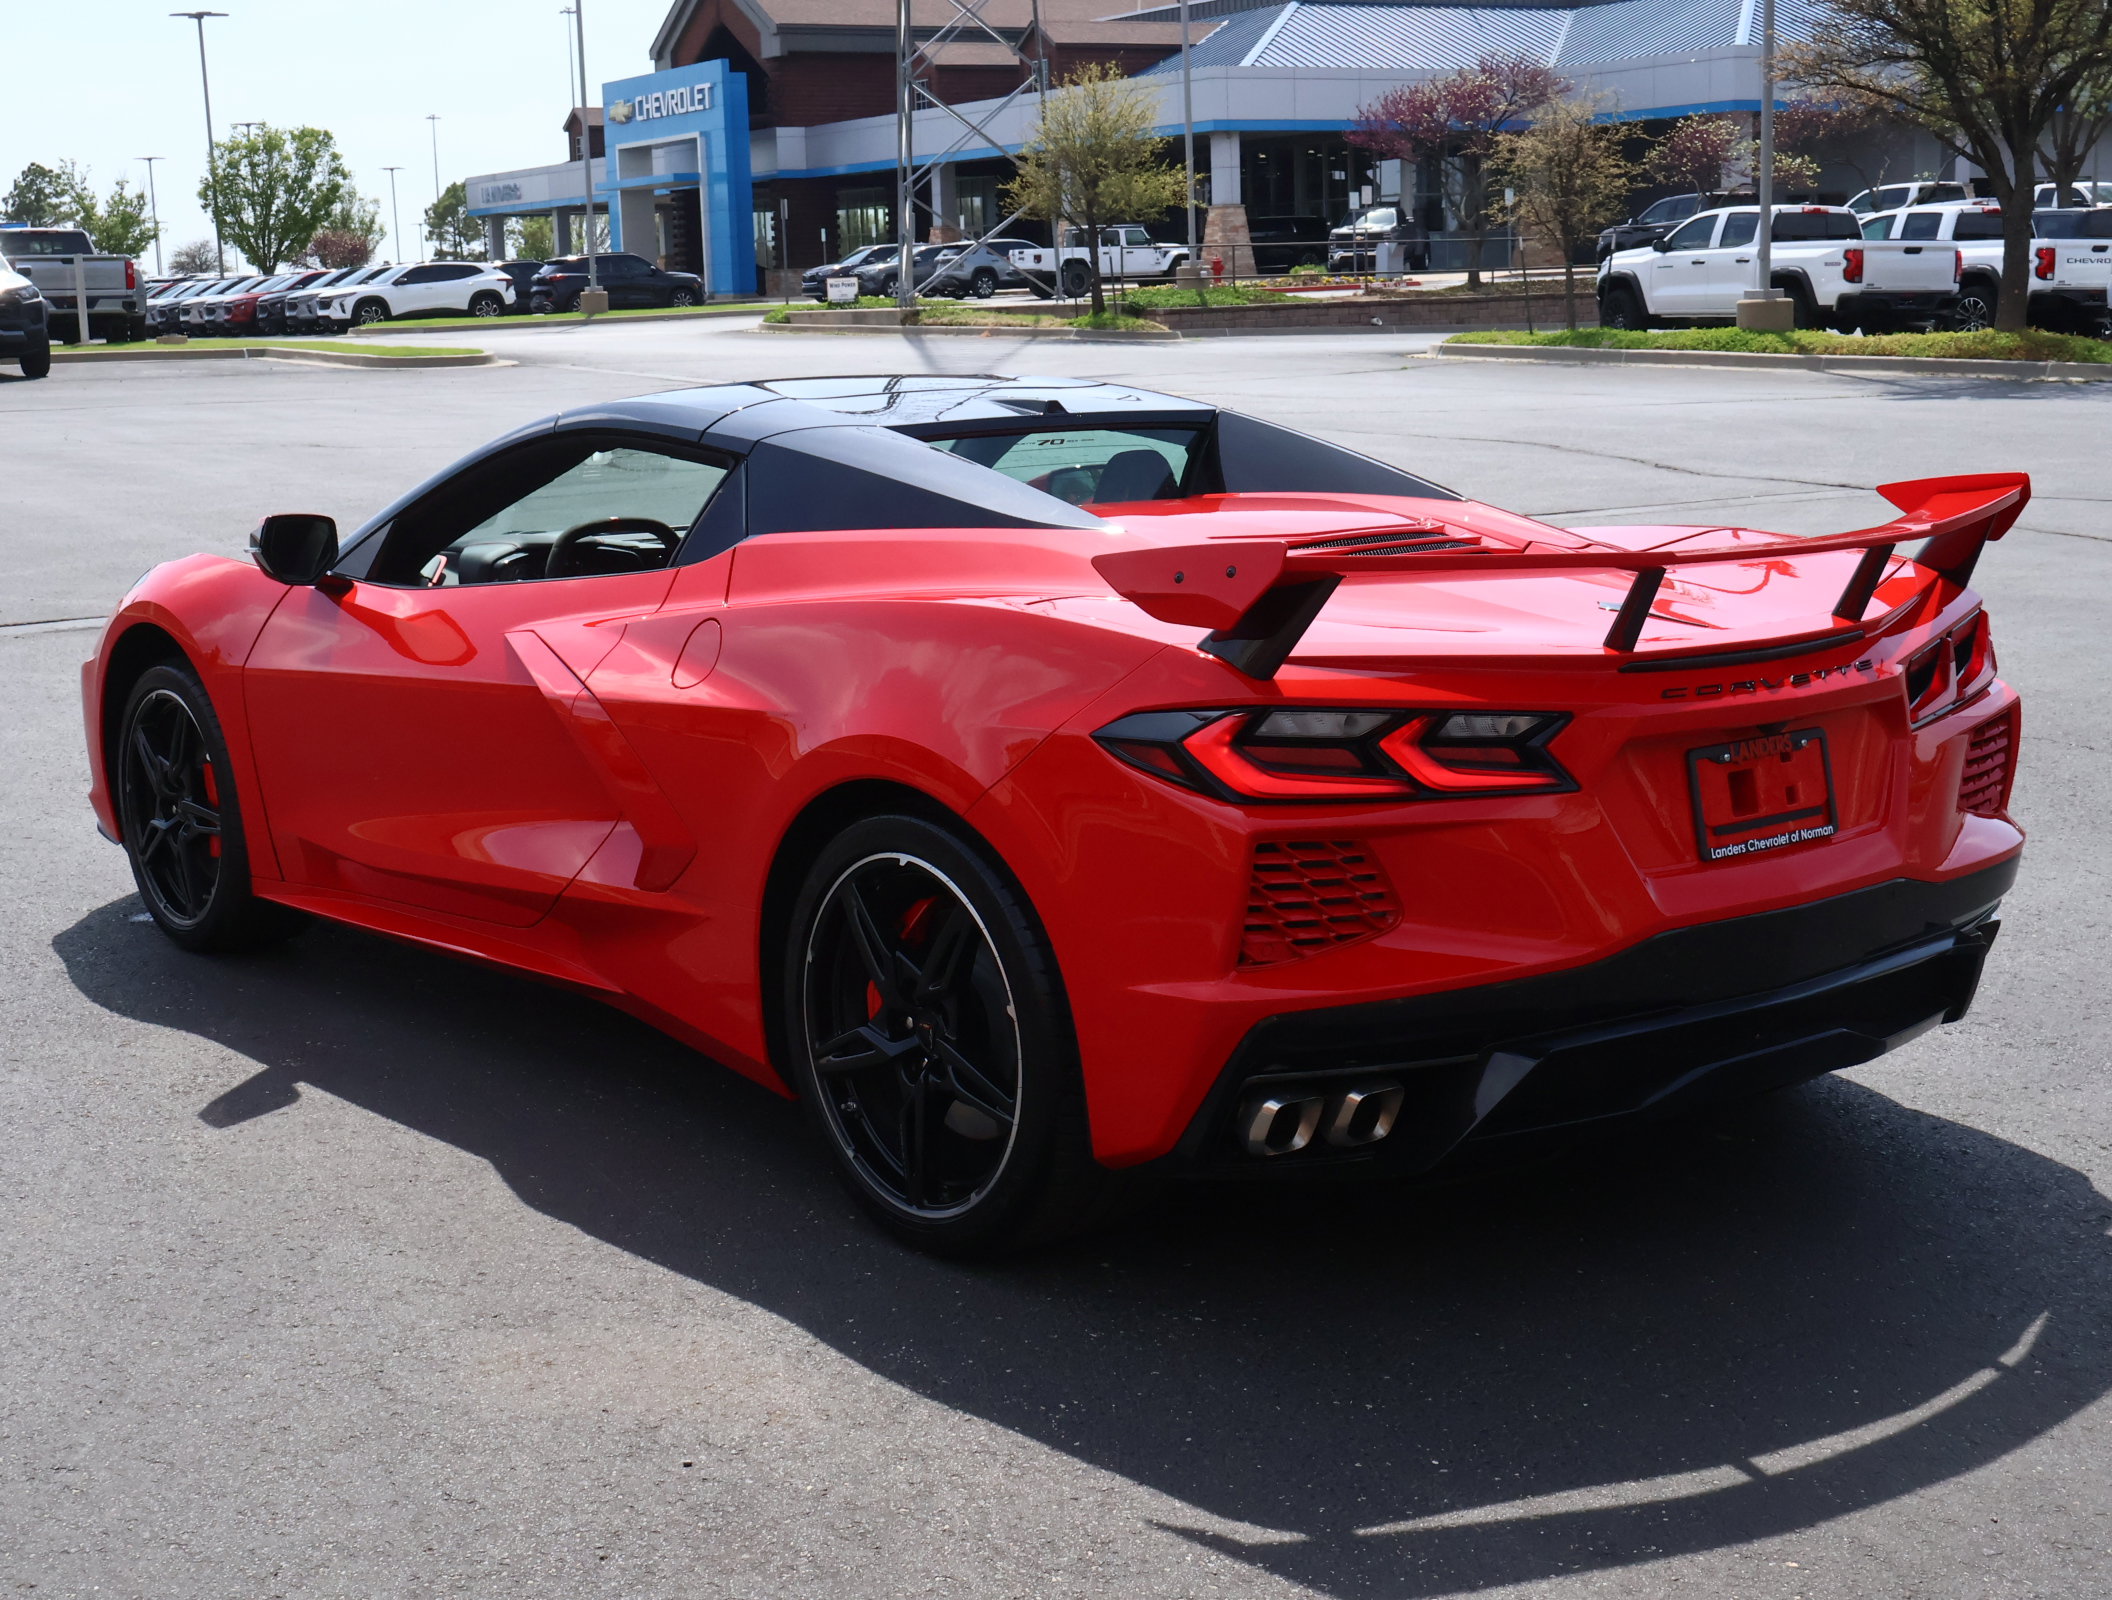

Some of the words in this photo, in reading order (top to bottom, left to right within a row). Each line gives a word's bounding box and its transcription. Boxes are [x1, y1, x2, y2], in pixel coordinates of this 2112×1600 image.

[635, 82, 711, 121] CHEVROLET
[1661, 659, 1873, 699] CORVETTE
[1729, 733, 1793, 762] LANDERS
[1711, 843, 1746, 859] Landers
[1747, 832, 1789, 852] Chevrolet
[1790, 829, 1800, 843] of
[1801, 825, 1834, 841] Norman
